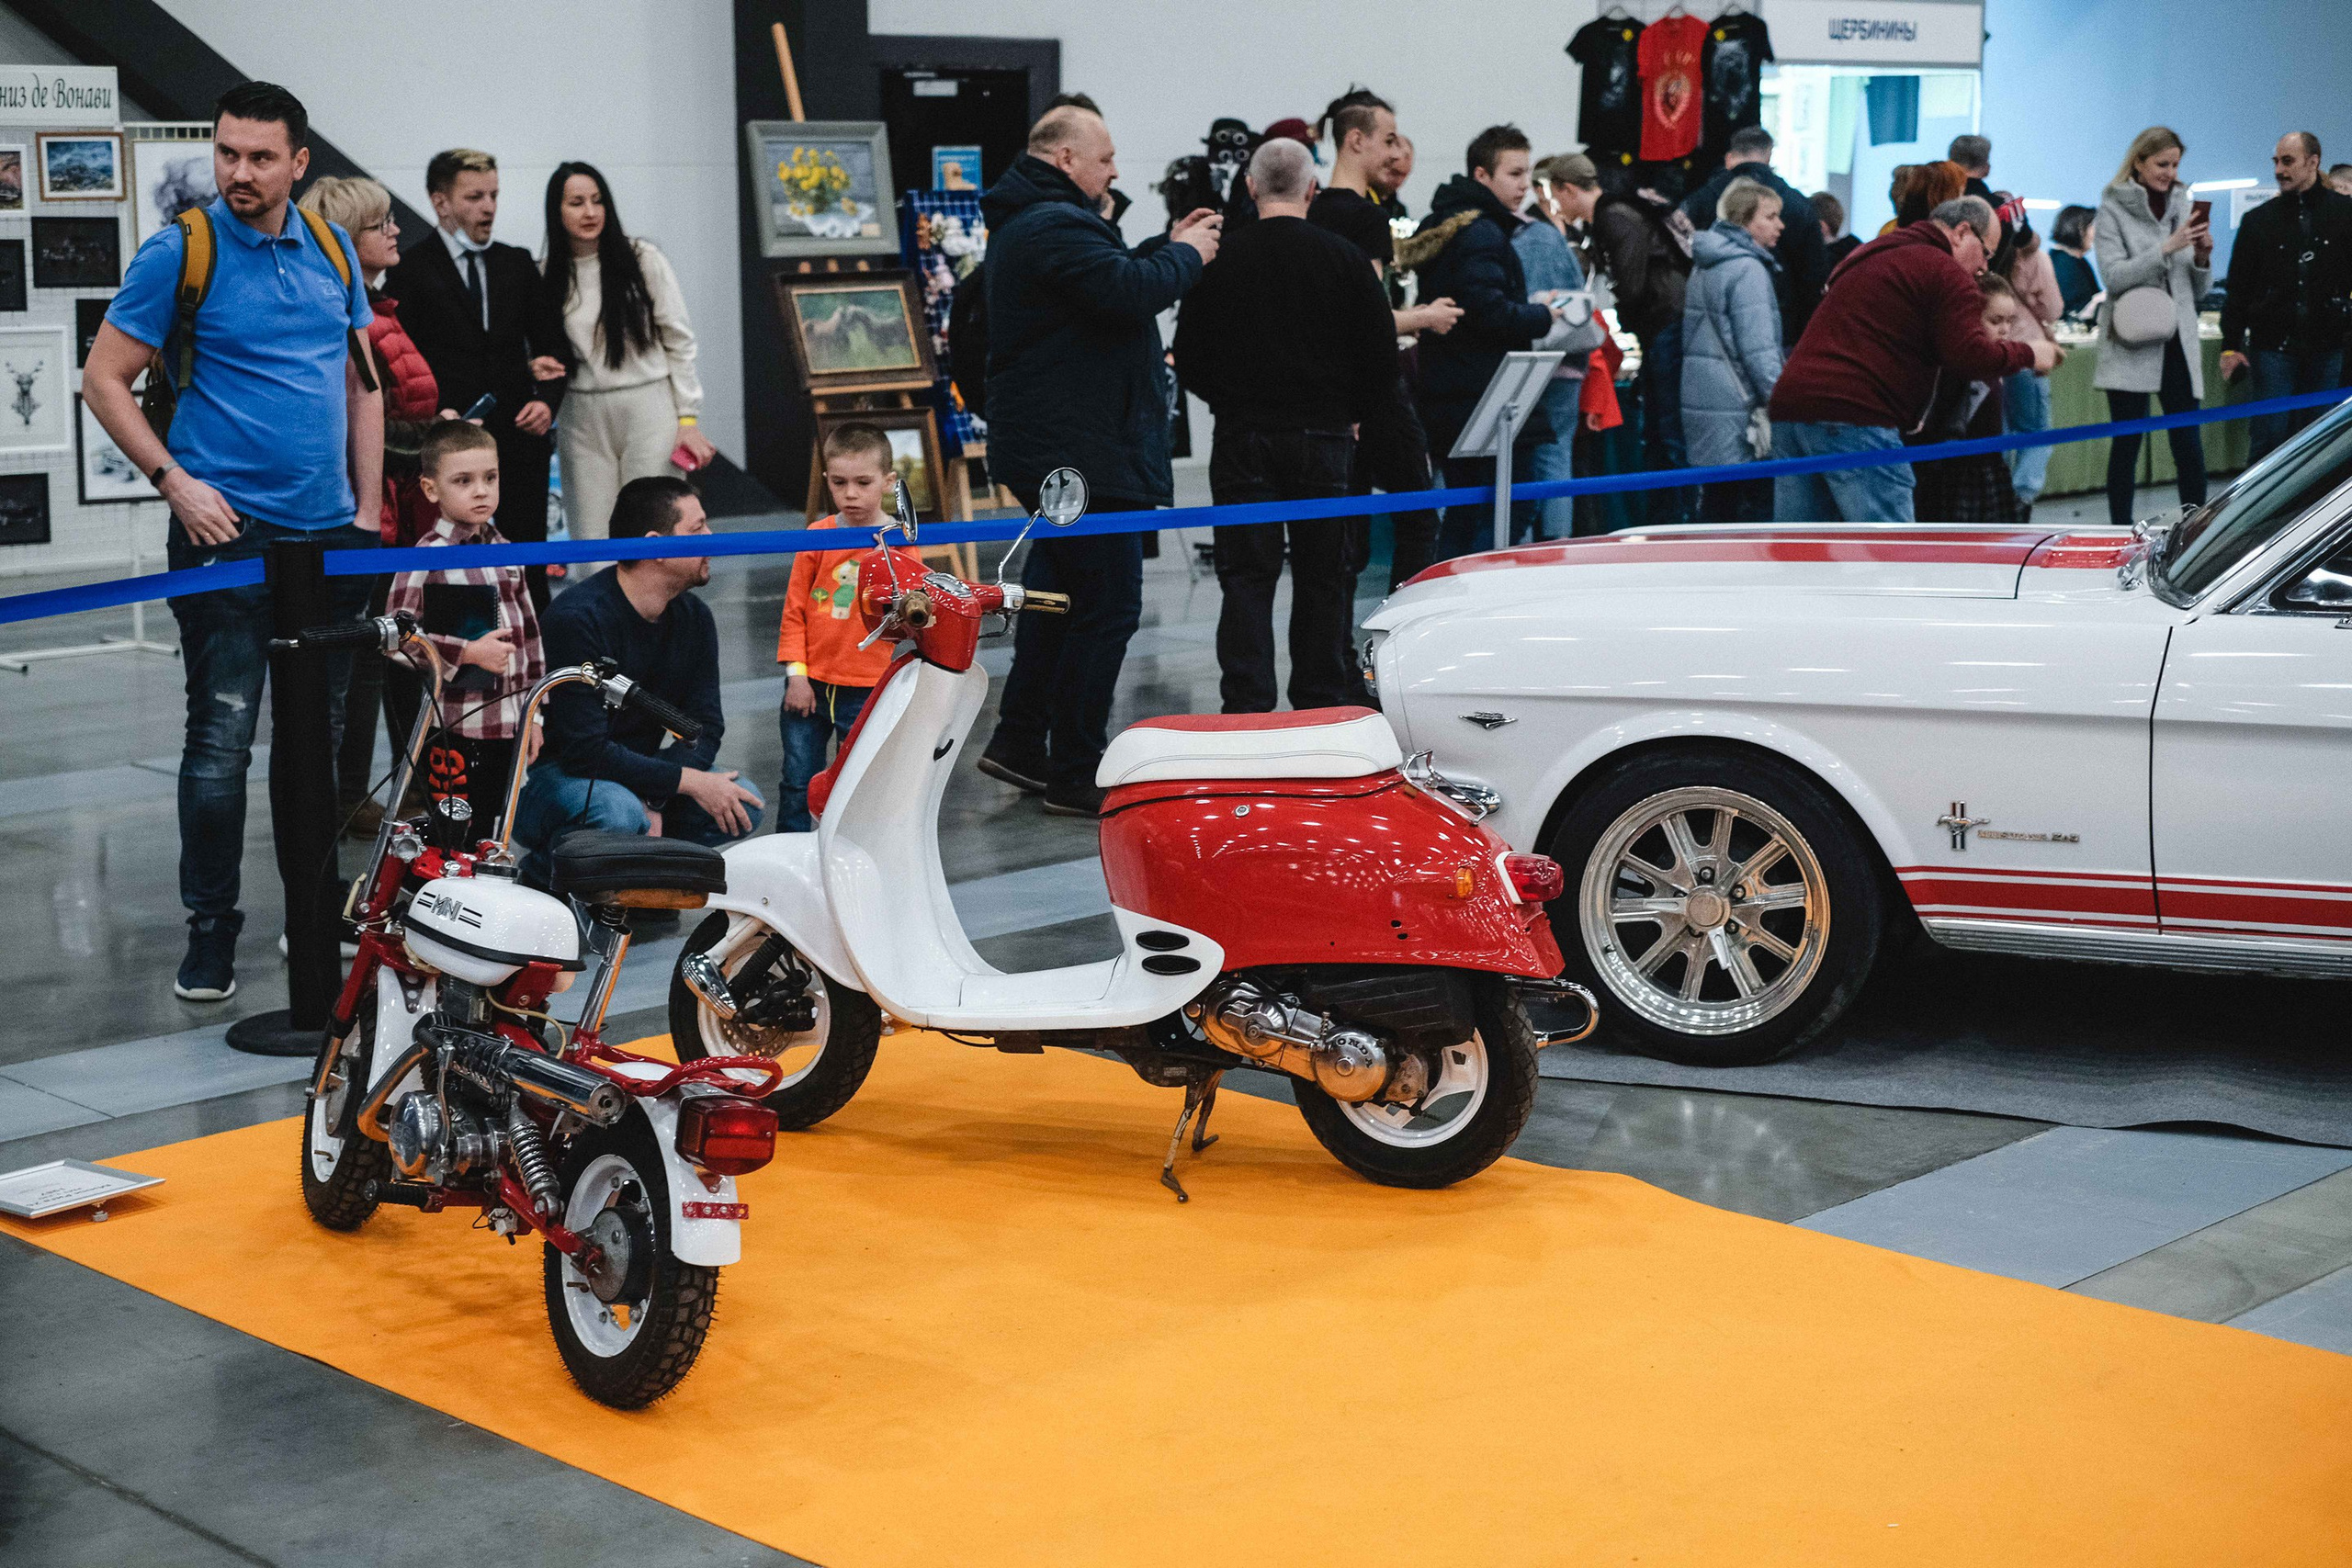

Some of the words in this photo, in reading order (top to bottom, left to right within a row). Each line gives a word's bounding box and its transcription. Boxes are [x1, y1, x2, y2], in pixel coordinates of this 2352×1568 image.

[1827, 17, 1917, 41] ЩЕРБИНИНЫ
[31, 73, 48, 108] де
[52, 78, 111, 109] Вонави
